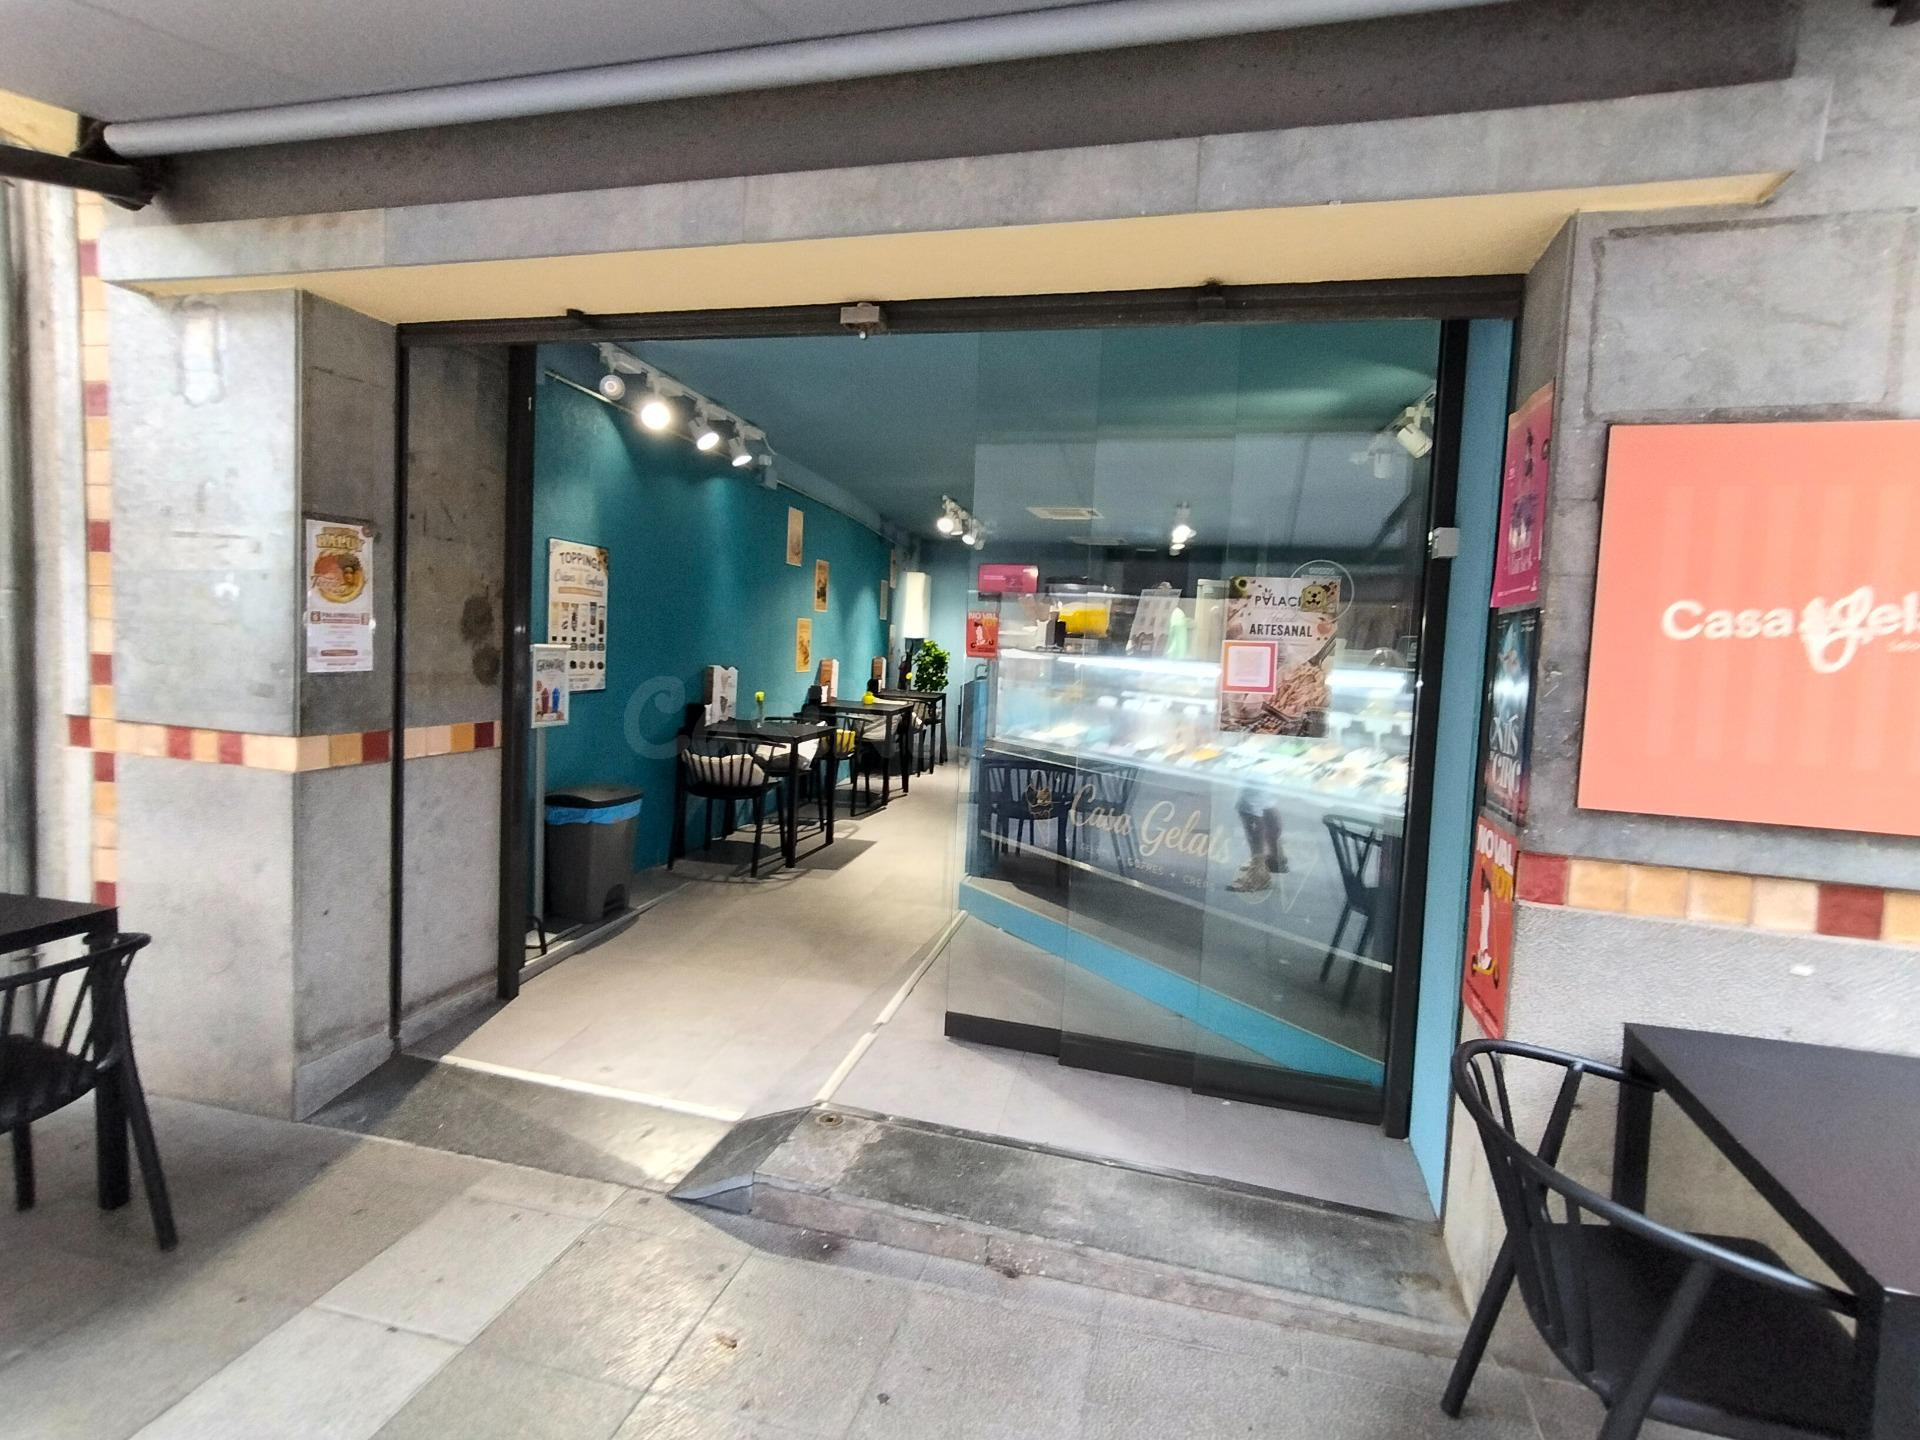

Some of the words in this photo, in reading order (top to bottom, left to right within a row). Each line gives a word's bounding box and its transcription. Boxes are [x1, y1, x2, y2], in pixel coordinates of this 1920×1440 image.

[1249, 623, 1313, 637] ARTESANAL
[1661, 599, 1795, 640] Casa
[1069, 783, 1132, 836] Casa
[1139, 800, 1231, 864] Gelats
[1477, 824, 1493, 859] NO
